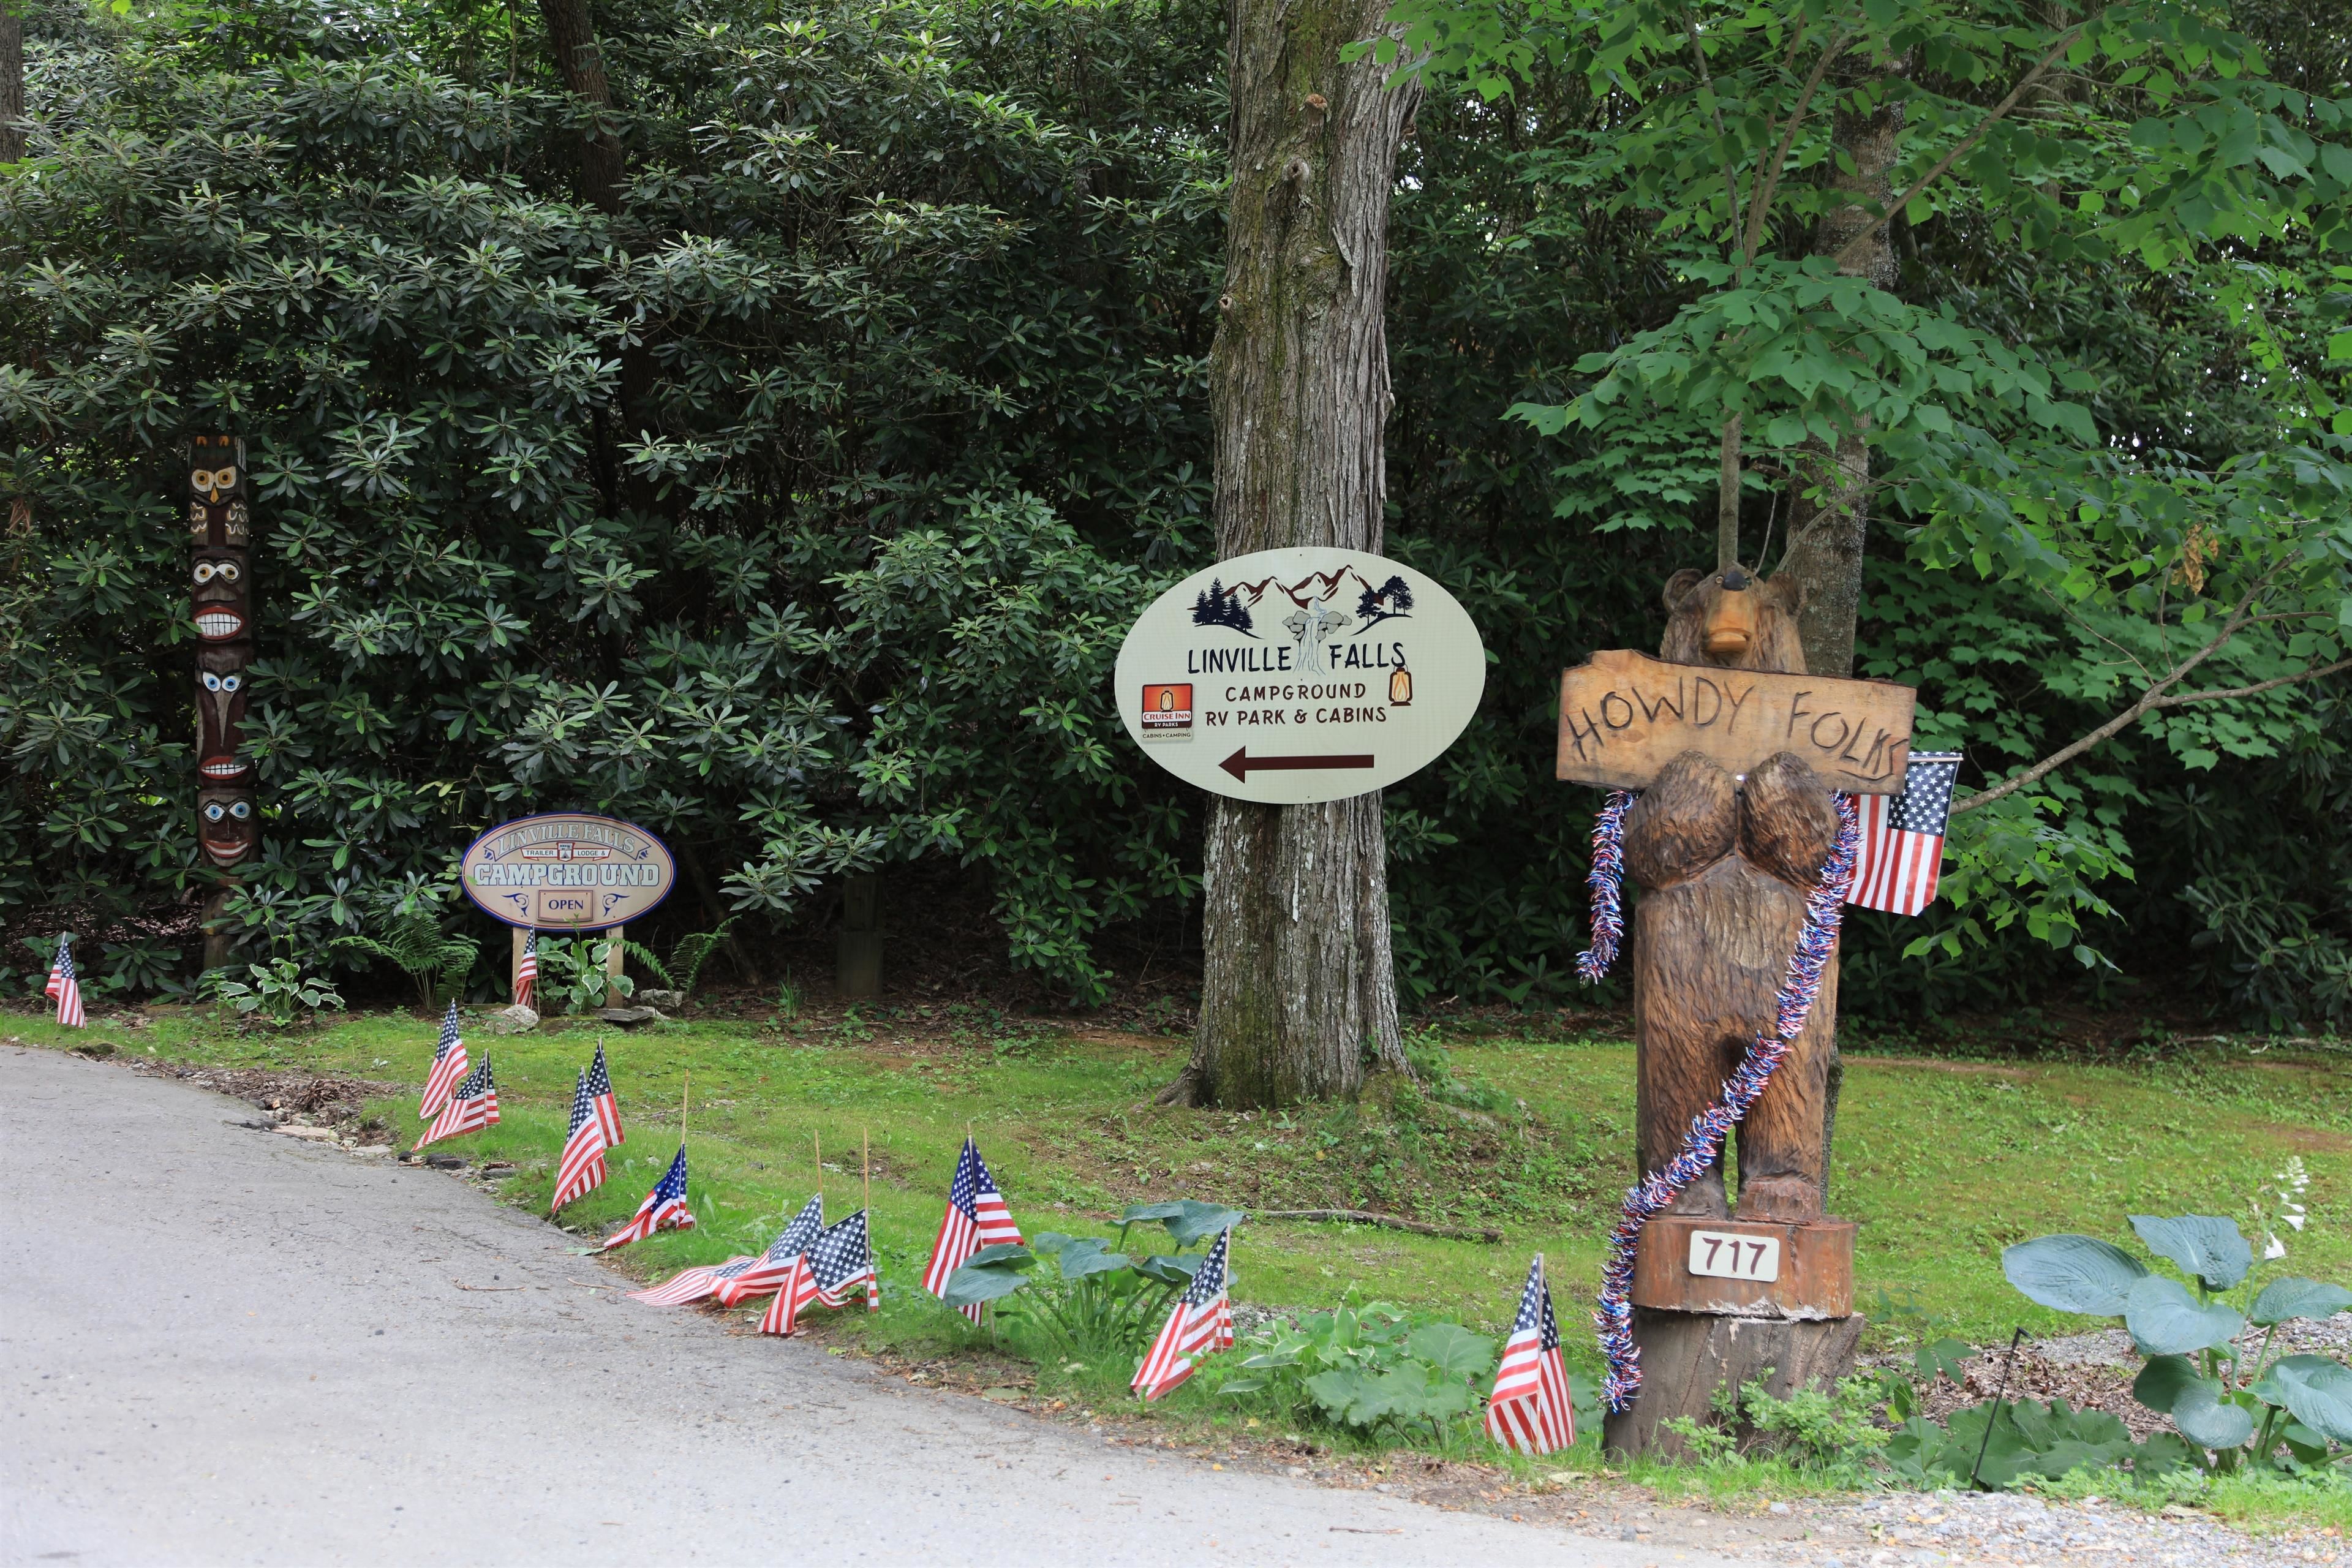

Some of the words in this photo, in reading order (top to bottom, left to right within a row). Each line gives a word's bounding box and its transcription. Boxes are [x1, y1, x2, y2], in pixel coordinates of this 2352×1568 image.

[1188, 646, 1292, 674] LINVILLE
[1329, 642, 1406, 669] FALLS
[1225, 683, 1366, 702] CAMPGROUND
[1205, 711, 1228, 726] RV
[1238, 709, 1286, 725] PARK
[1294, 709, 1307, 723] &
[1316, 706, 1387, 723] CABINS
[1566, 676, 1755, 762] HOWDY
[497, 824, 579, 856] LINVILLE
[582, 823, 635, 853] FALLS
[473, 864, 660, 887] CAMPGROUND
[548, 899, 584, 910] OPEN
[1702, 1237, 1768, 1275] 717
